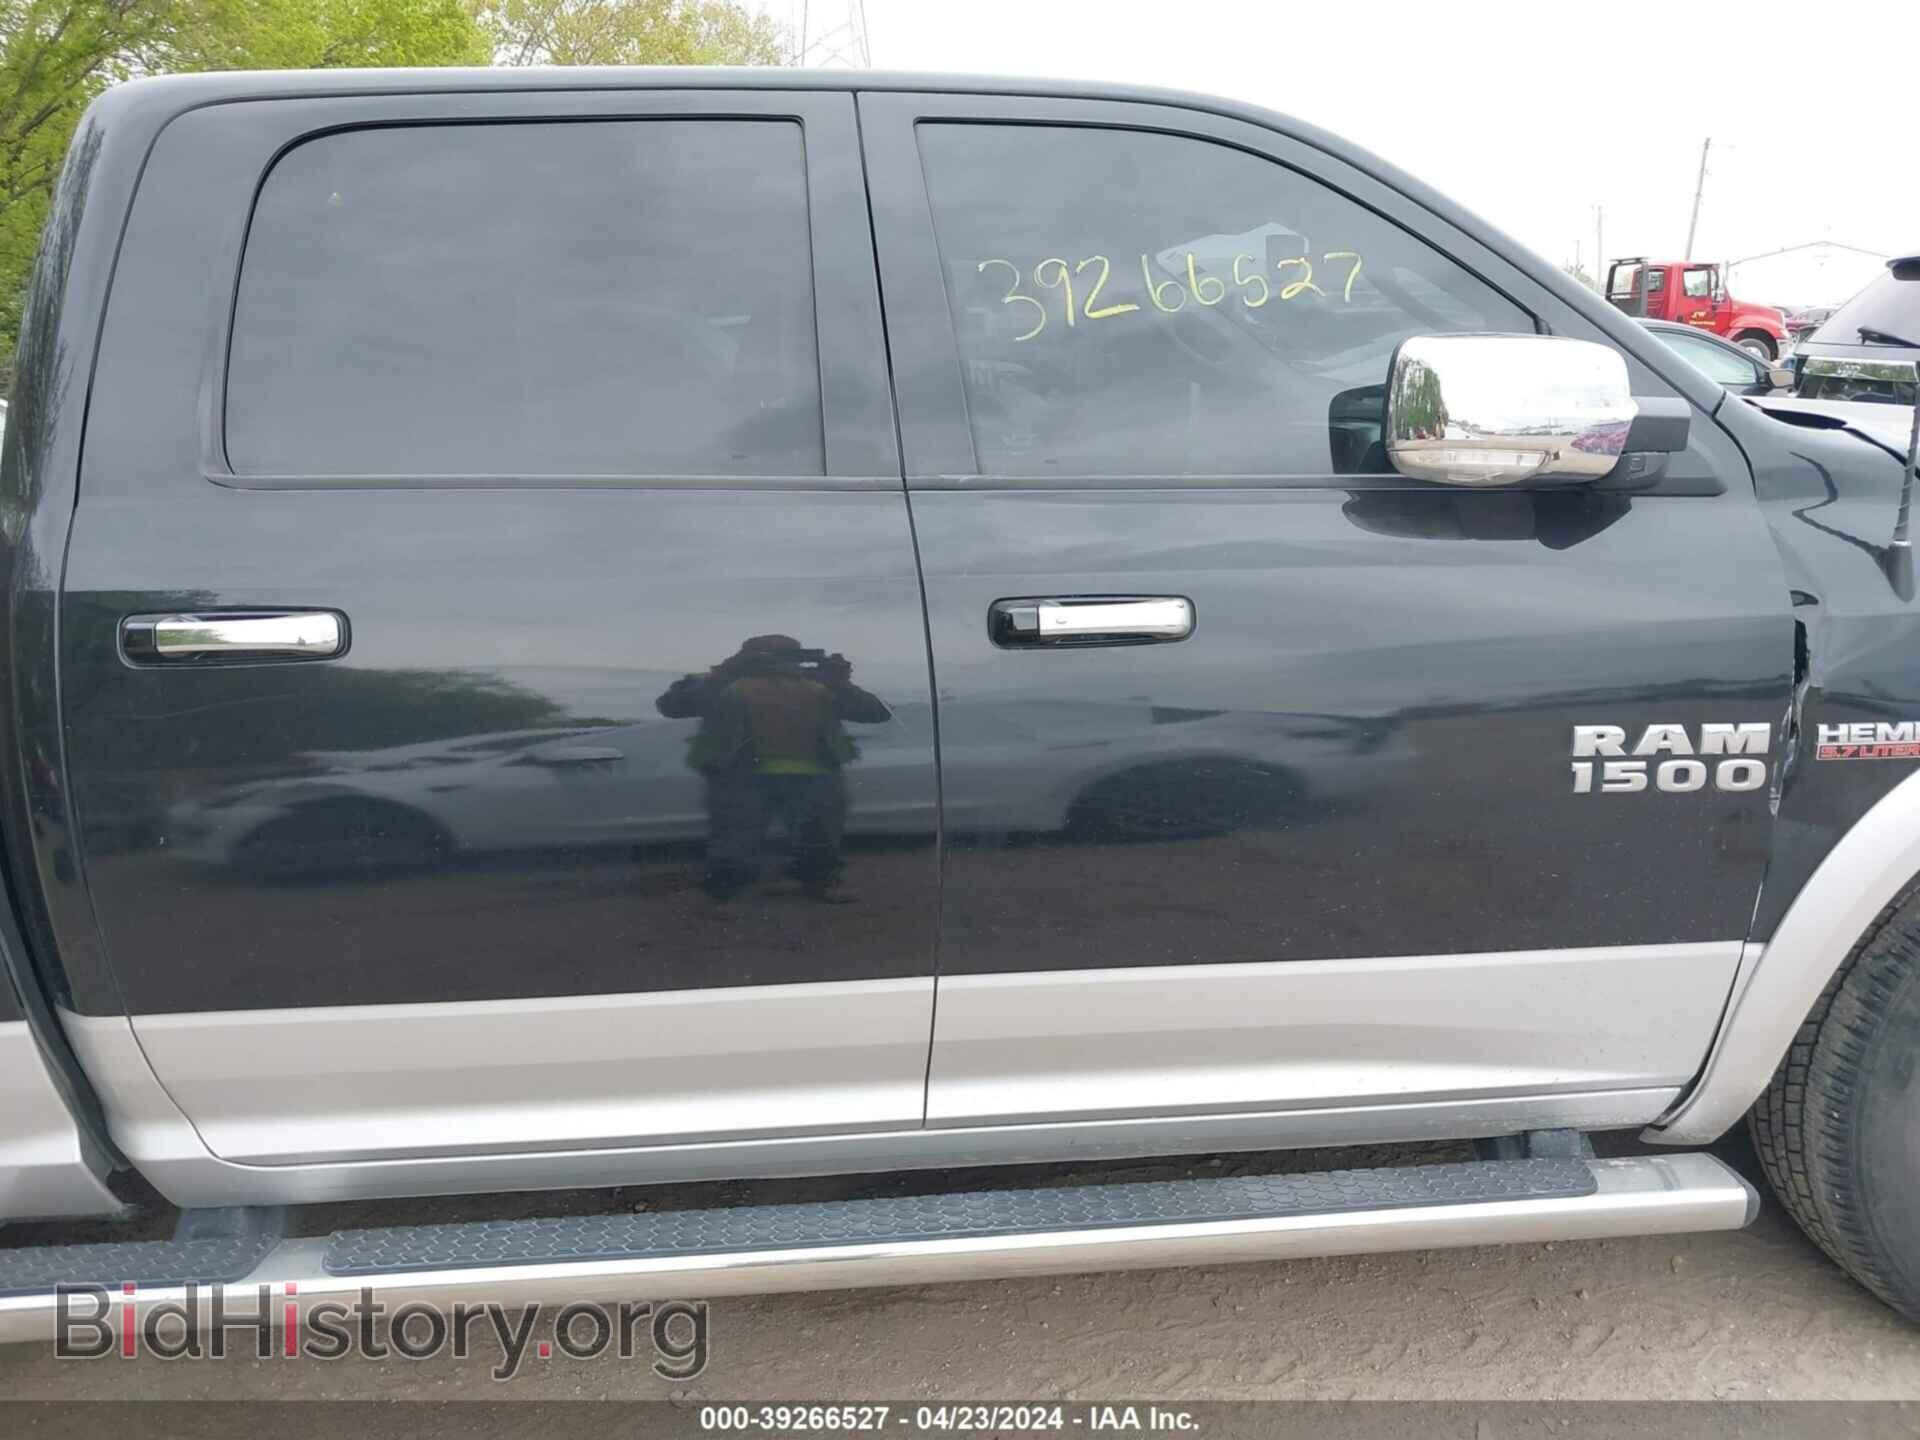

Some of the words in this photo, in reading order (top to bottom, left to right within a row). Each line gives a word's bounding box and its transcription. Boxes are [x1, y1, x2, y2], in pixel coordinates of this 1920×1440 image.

[977, 251, 1362, 341] 39266527
[1571, 722, 1771, 757] RAM
[1571, 759, 1767, 793] 1500
